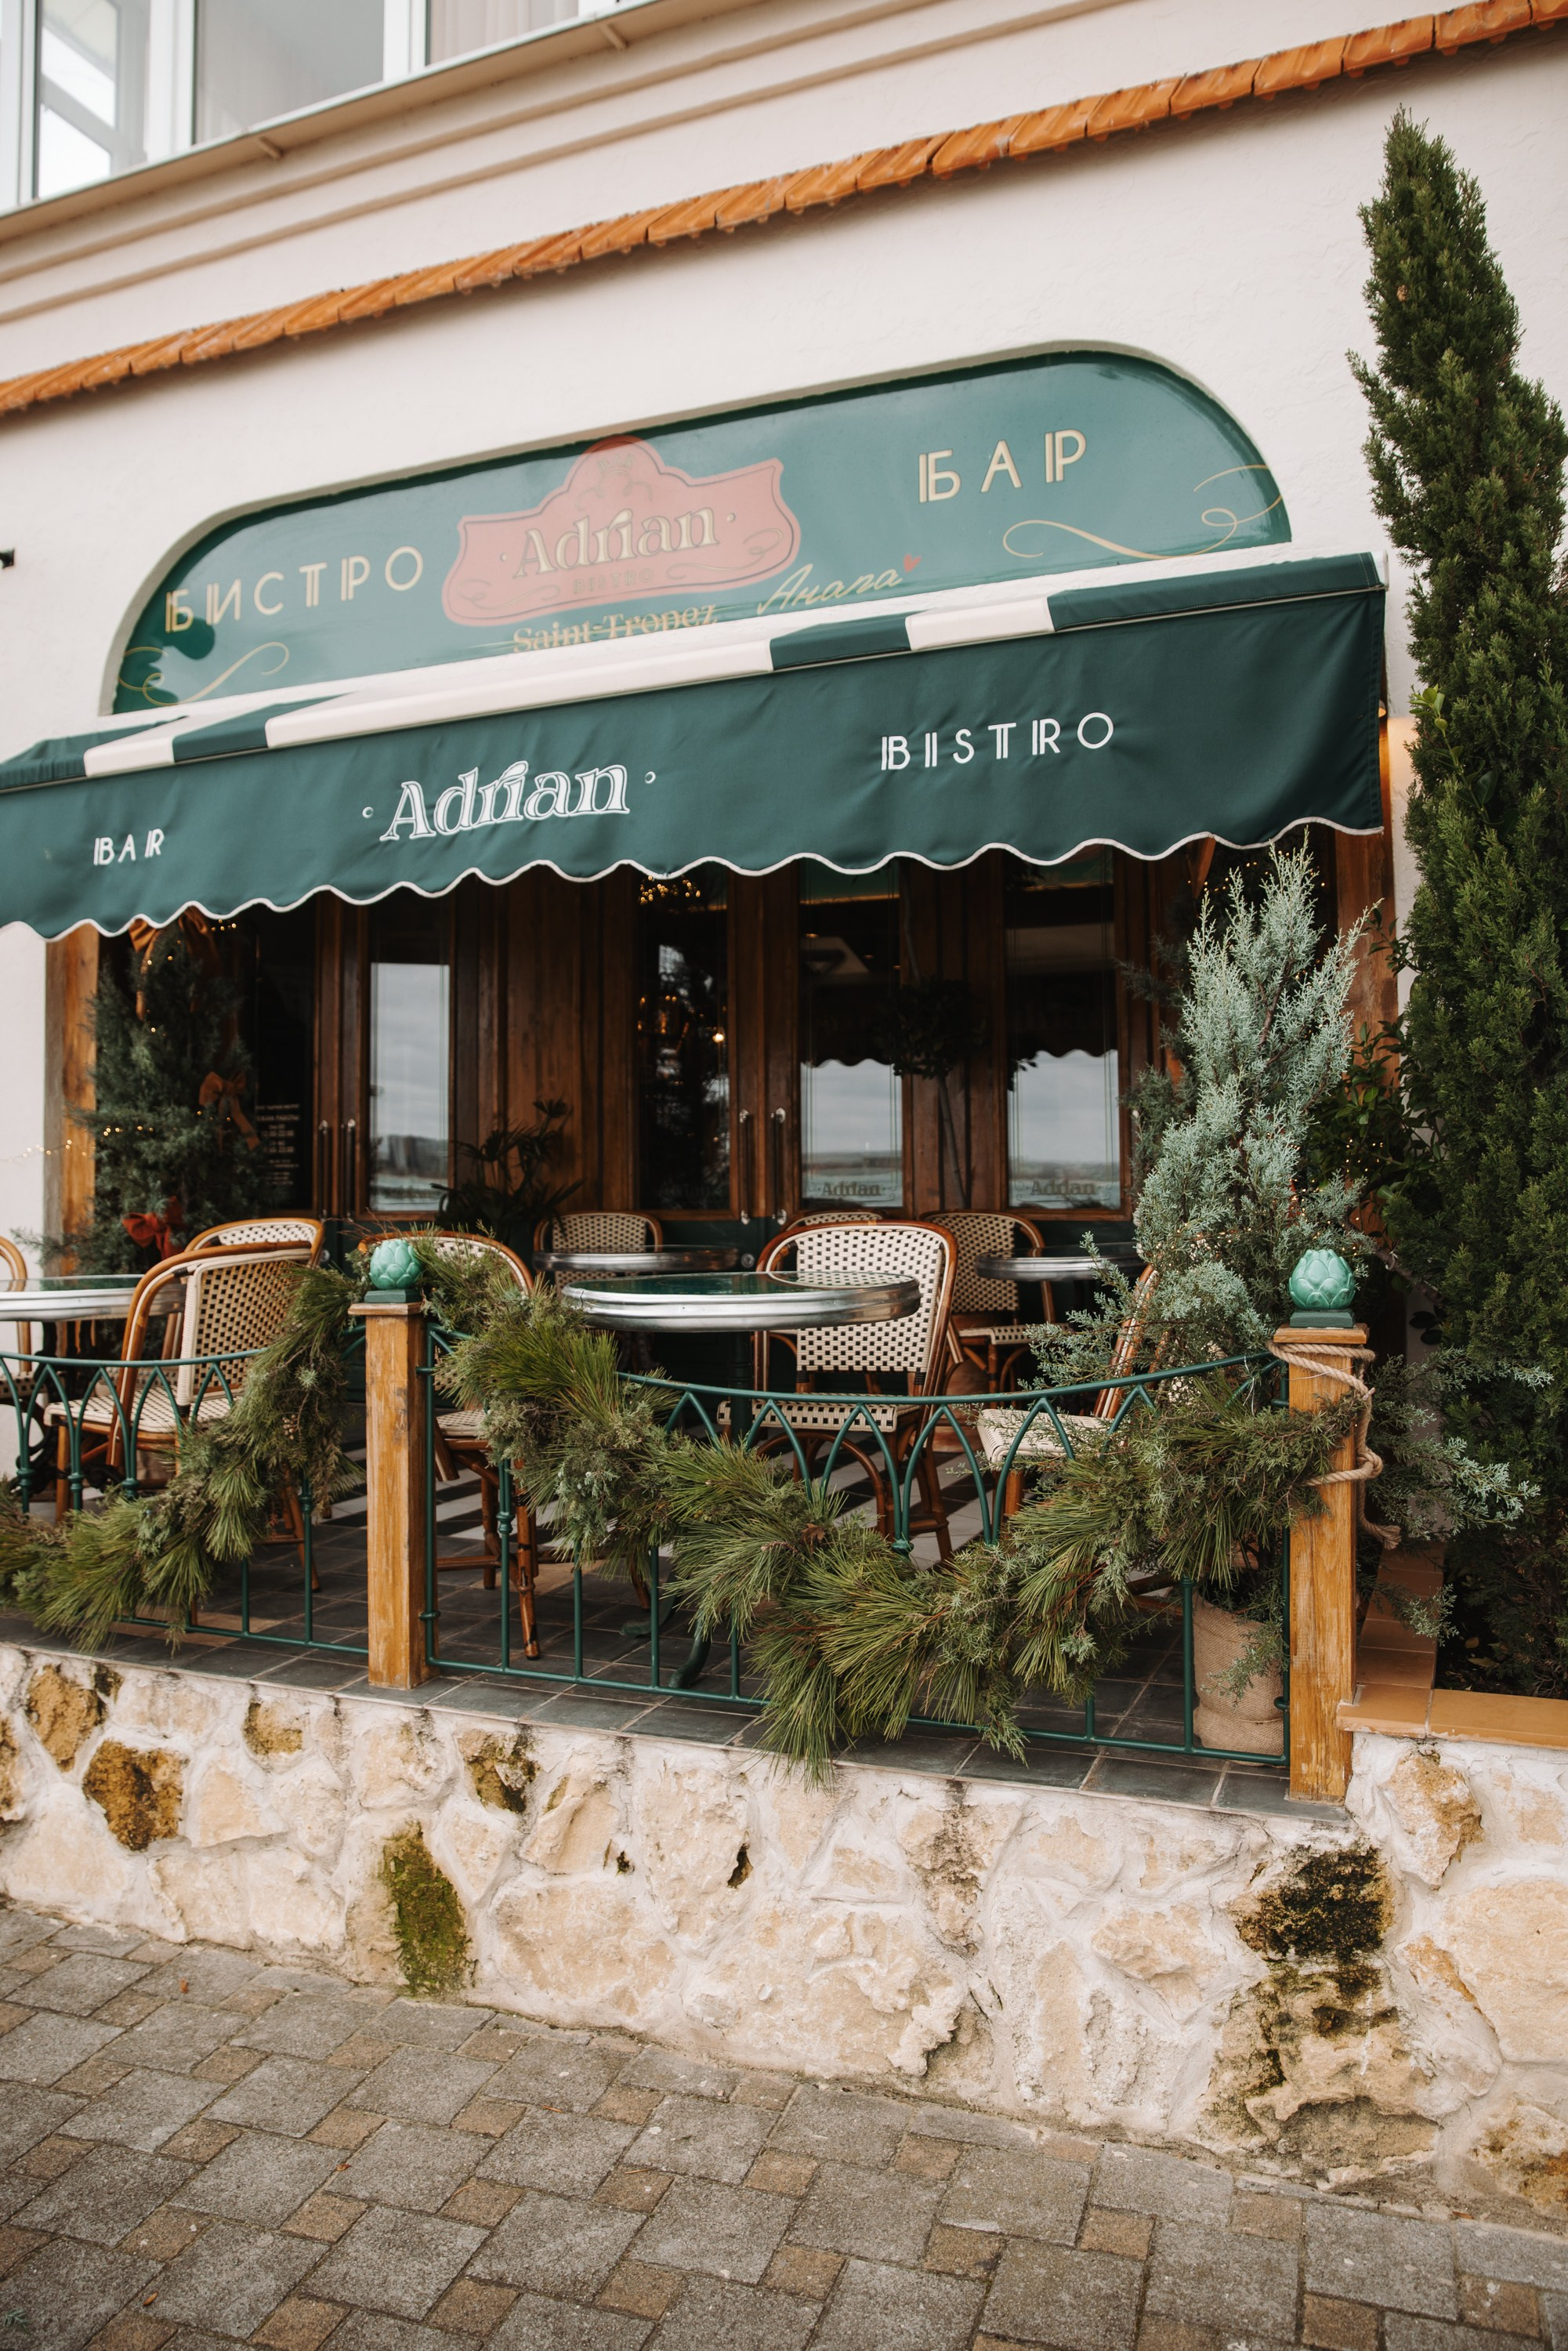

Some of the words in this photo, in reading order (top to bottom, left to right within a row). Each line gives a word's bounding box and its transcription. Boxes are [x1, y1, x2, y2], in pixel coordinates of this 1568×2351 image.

[918, 429, 1088, 504] БАР
[512, 506, 720, 578] Adrian
[165, 545, 424, 634] БИСТРО
[572, 567, 654, 595] BISTRO
[757, 563, 904, 615] Анапа
[512, 603, 719, 654] Saint-Tropez
[881, 712, 1114, 772] BISTRO
[380, 760, 631, 842] Adrian
[93, 828, 165, 867] BAR
[1029, 1178, 1098, 1196] Adrian
